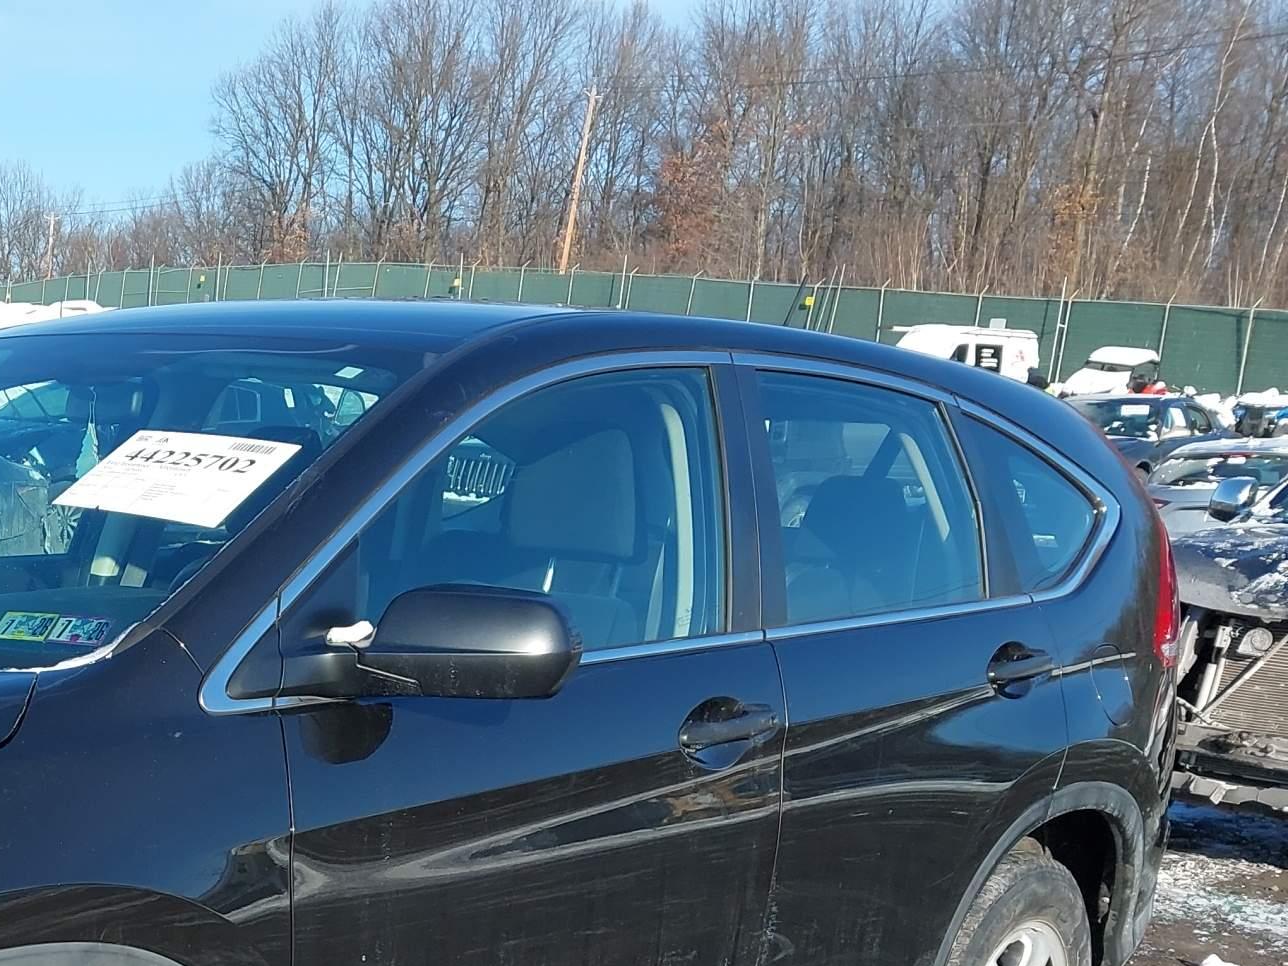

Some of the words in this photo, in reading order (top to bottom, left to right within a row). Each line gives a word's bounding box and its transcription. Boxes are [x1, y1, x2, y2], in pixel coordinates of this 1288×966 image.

[124, 446, 257, 474] 44225702
[0, 619, 16, 635] 7
[56, 619, 73, 639] 7
